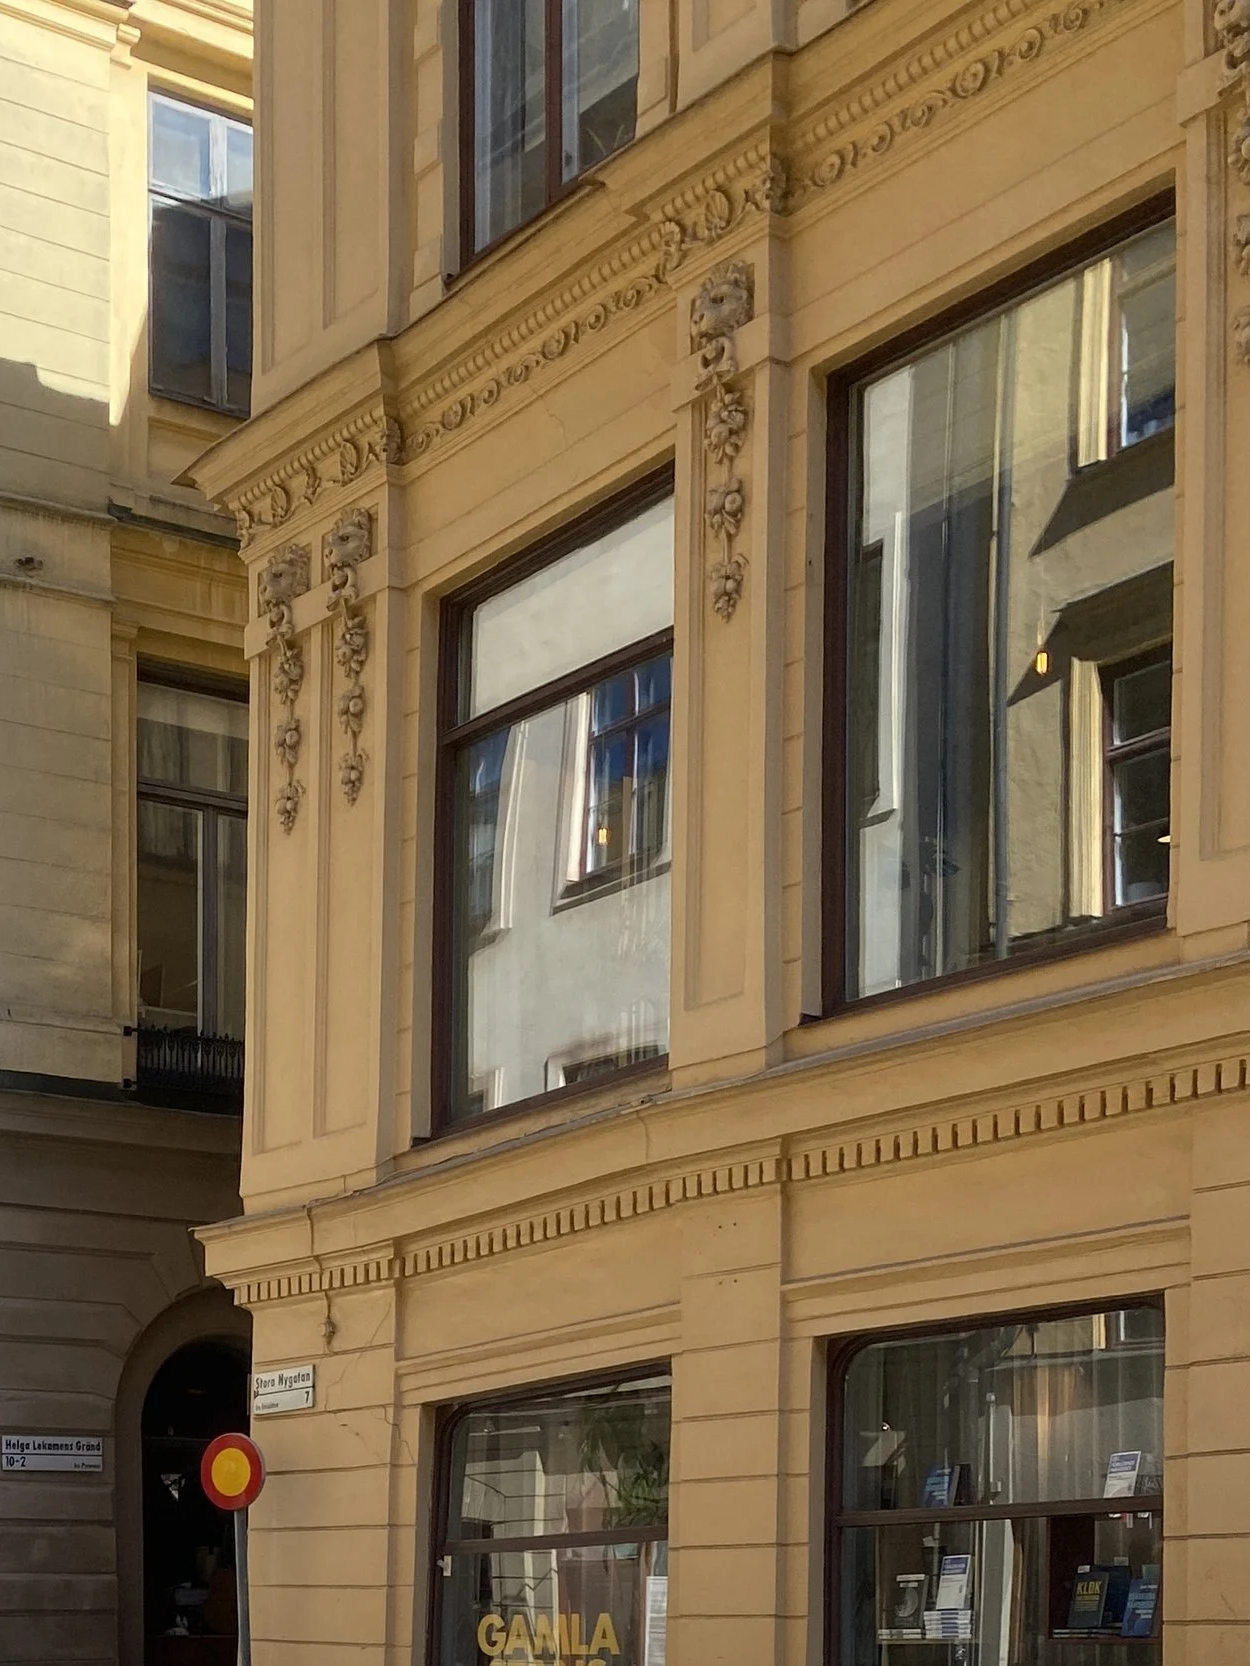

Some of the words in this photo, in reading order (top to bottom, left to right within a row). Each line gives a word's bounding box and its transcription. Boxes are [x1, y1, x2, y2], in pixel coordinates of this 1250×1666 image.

[255, 1377, 275, 1389] Stora
[278, 1372, 311, 1389] Nygatan
[305, 1390, 310, 1404] 7
[5, 1439, 30, 1454] Helga
[33, 1440, 73, 1452] Lekamens
[76, 1440, 101, 1452] Gränd
[5, 1456, 26, 1468] 10-2
[477, 1612, 621, 1656] GAMLA
